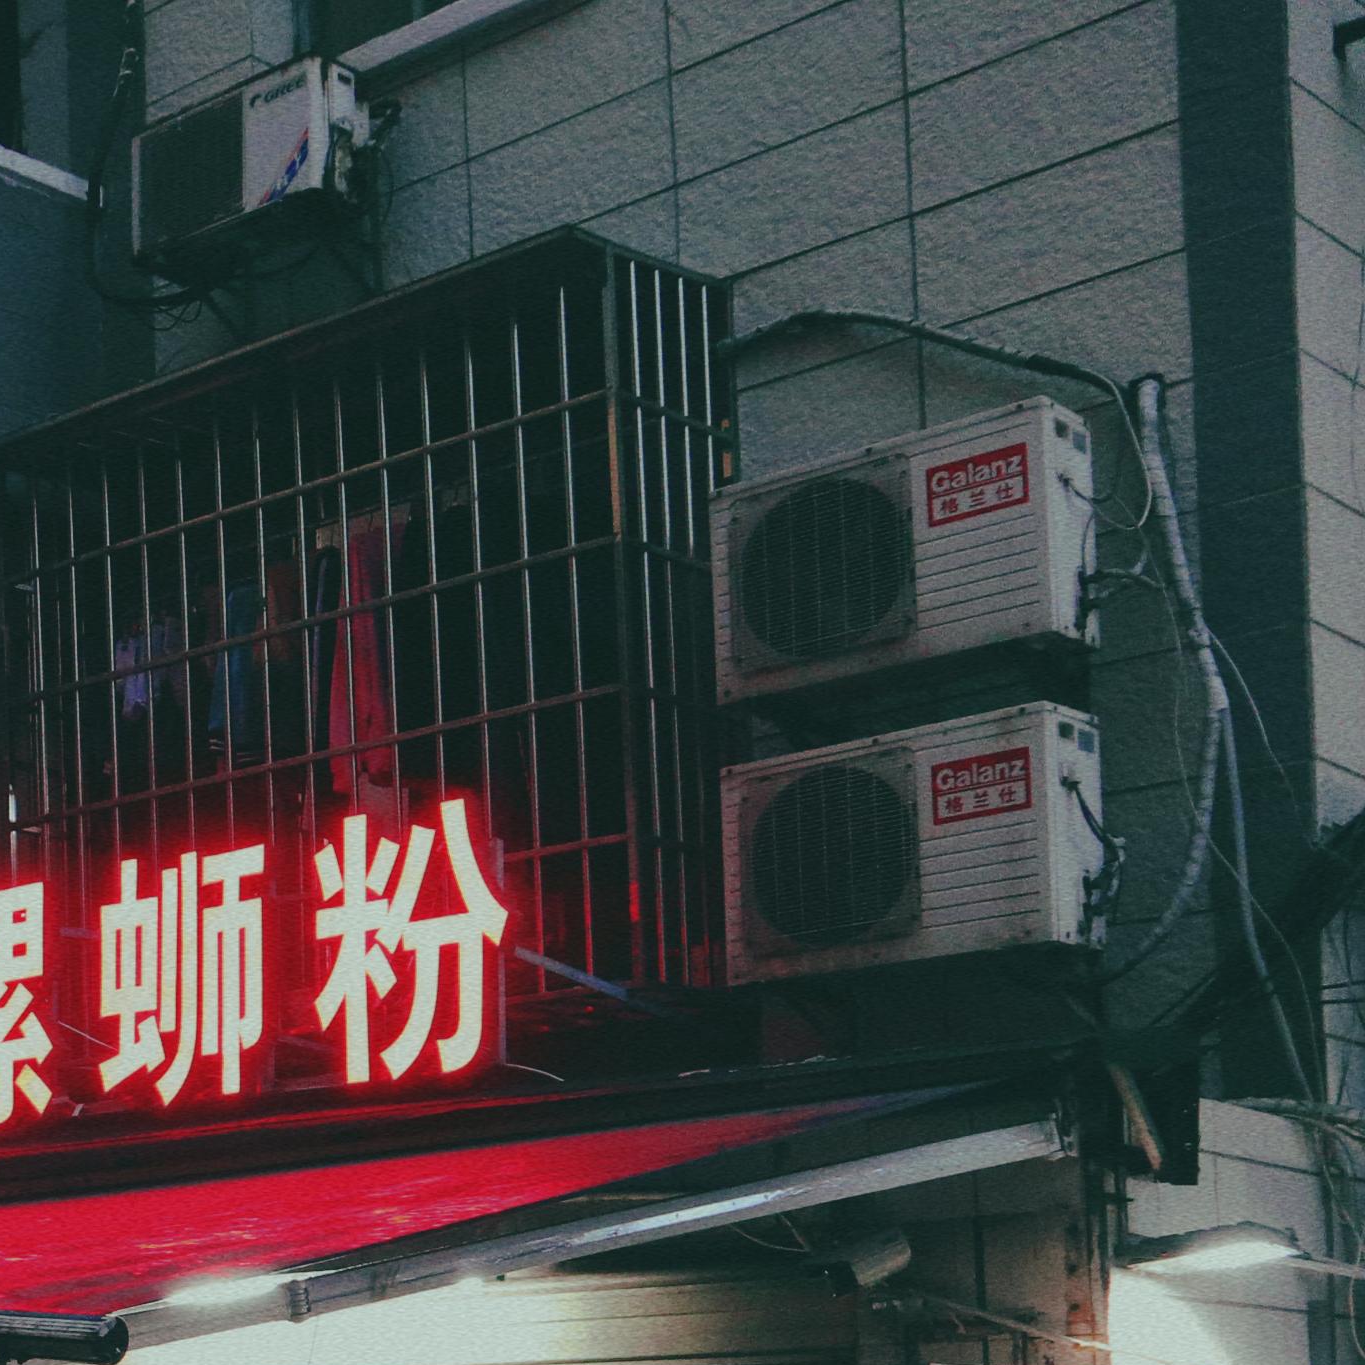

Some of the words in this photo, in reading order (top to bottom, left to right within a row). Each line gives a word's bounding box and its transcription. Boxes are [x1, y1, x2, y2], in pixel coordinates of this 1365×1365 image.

[933, 456, 1023, 492] Galanz
[939, 481, 1014, 516] 格兰仕
[936, 759, 1026, 790] Galanz
[943, 786, 1017, 815] 格兰仕
